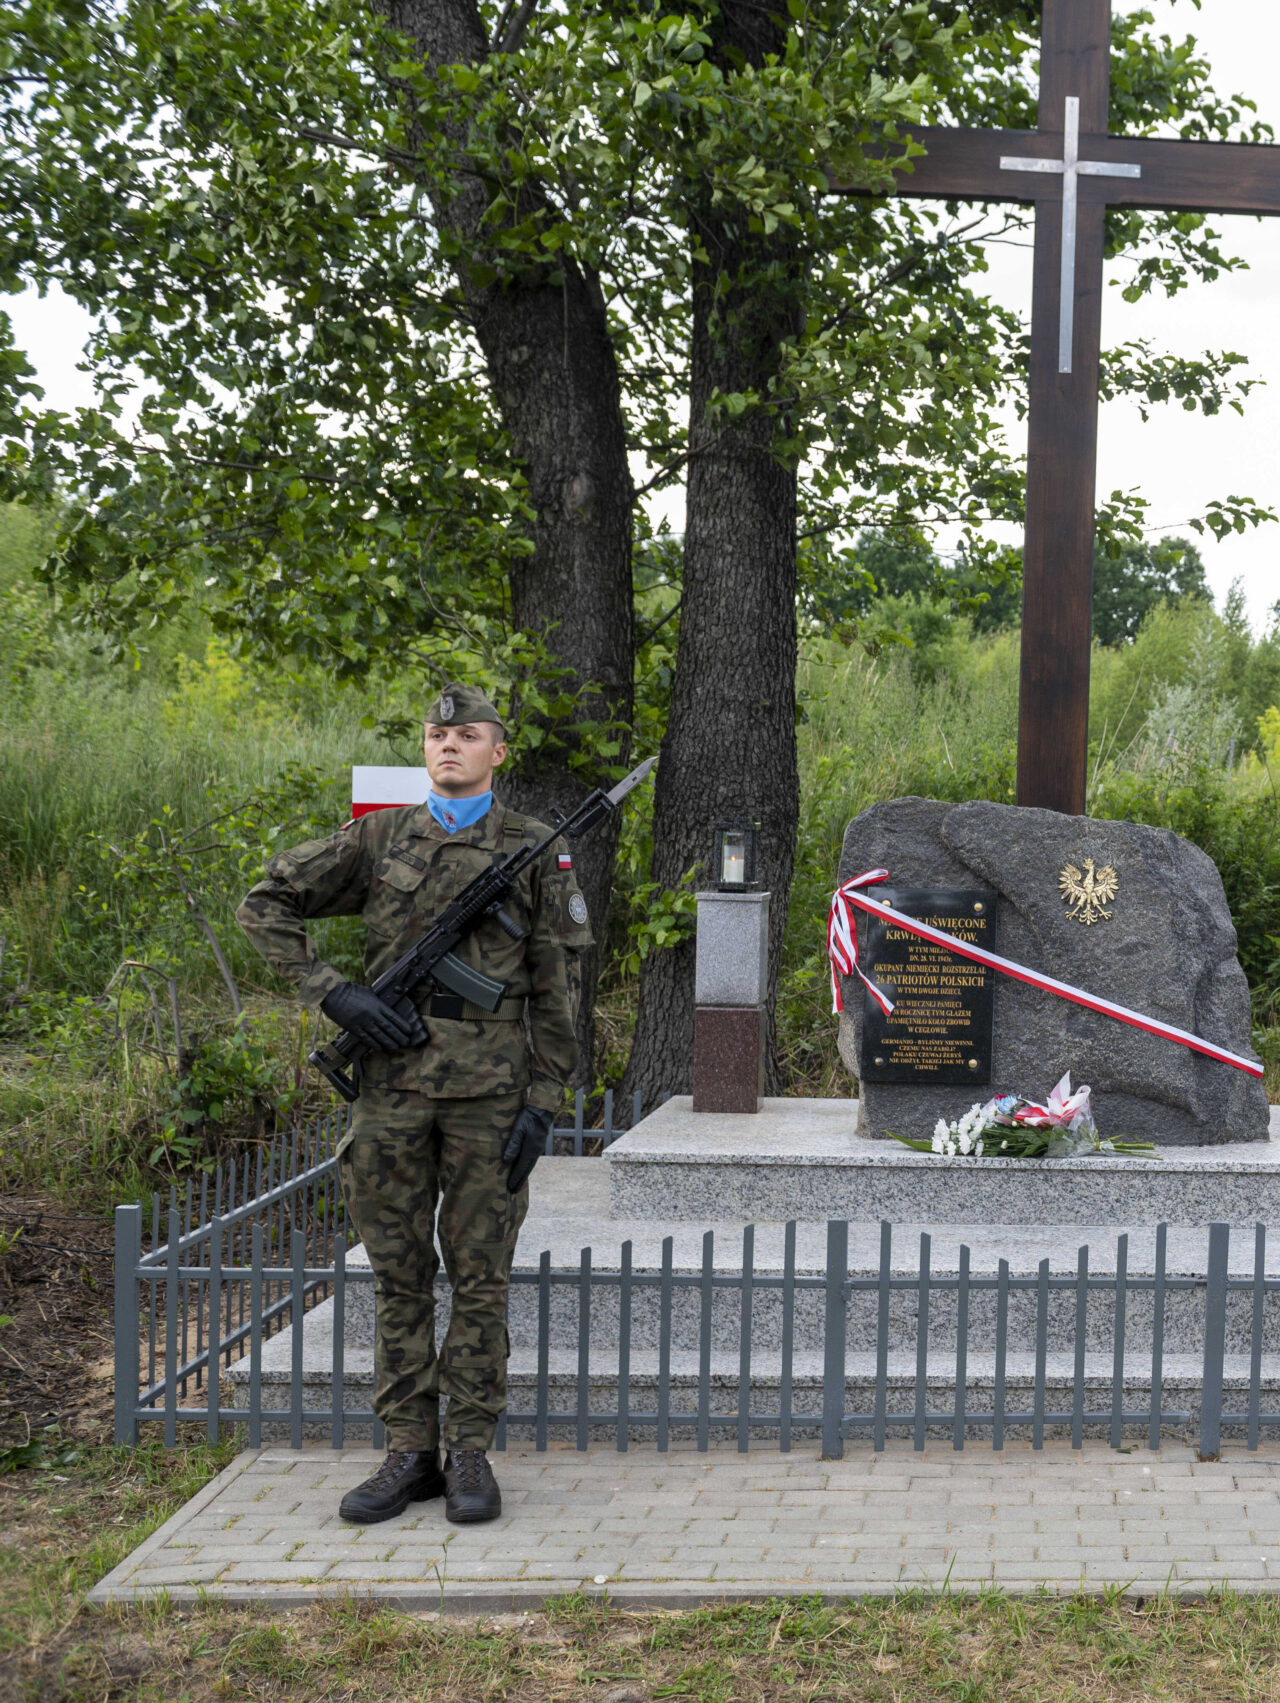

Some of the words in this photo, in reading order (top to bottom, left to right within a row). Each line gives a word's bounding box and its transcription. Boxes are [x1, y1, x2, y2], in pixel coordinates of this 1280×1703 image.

[925, 915, 987, 930] UŚWIĘCONE
[873, 963, 904, 972] OKUPANT
[905, 964, 940, 973] NIEMIECKI
[876, 974, 885, 984] 26
[886, 973, 939, 985] PATRIOTÓW
[940, 975, 985, 987] POLSKICH
[918, 987, 939, 995] DWOJE
[932, 1009, 945, 1017] TYM
